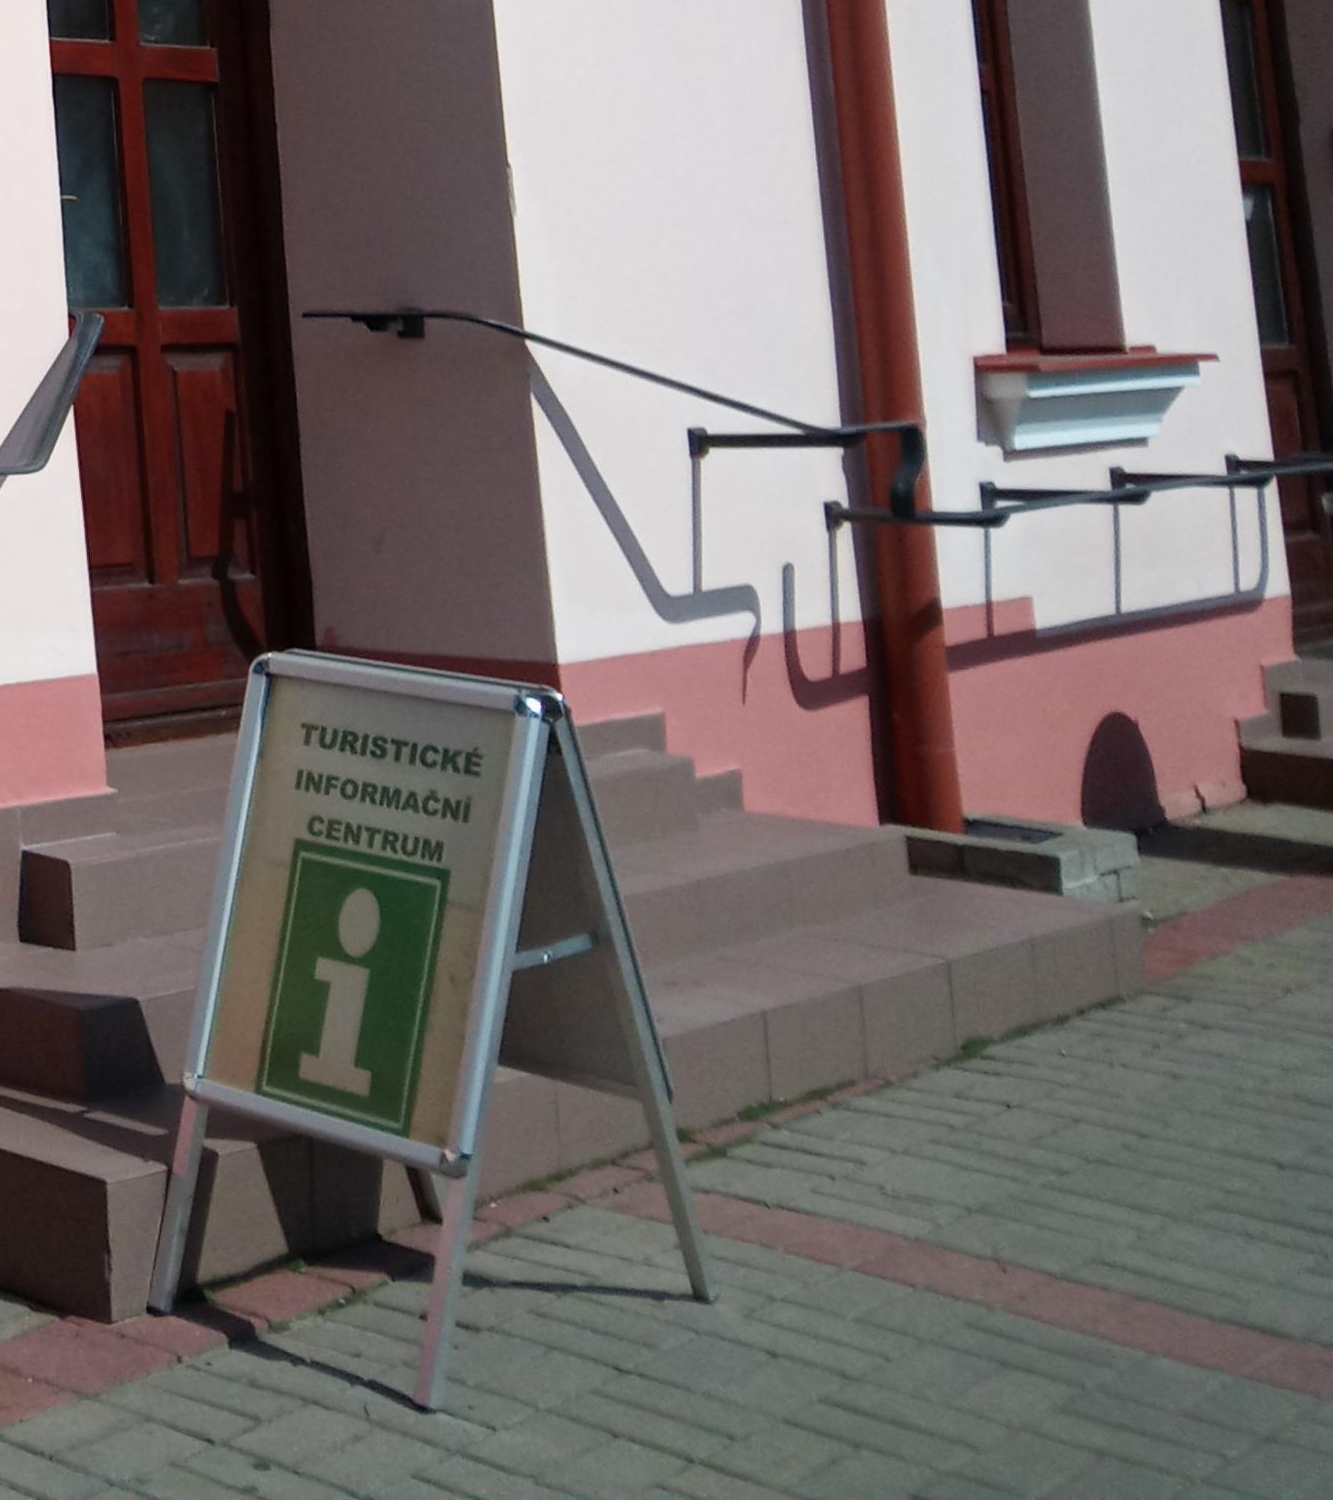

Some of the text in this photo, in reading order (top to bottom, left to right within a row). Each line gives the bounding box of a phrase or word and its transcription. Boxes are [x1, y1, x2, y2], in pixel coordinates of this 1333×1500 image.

[301, 722, 484, 777] TURISTICKÉ
[295, 768, 472, 823] INFORMAČNÍ
[307, 814, 445, 863] CENTRUM
